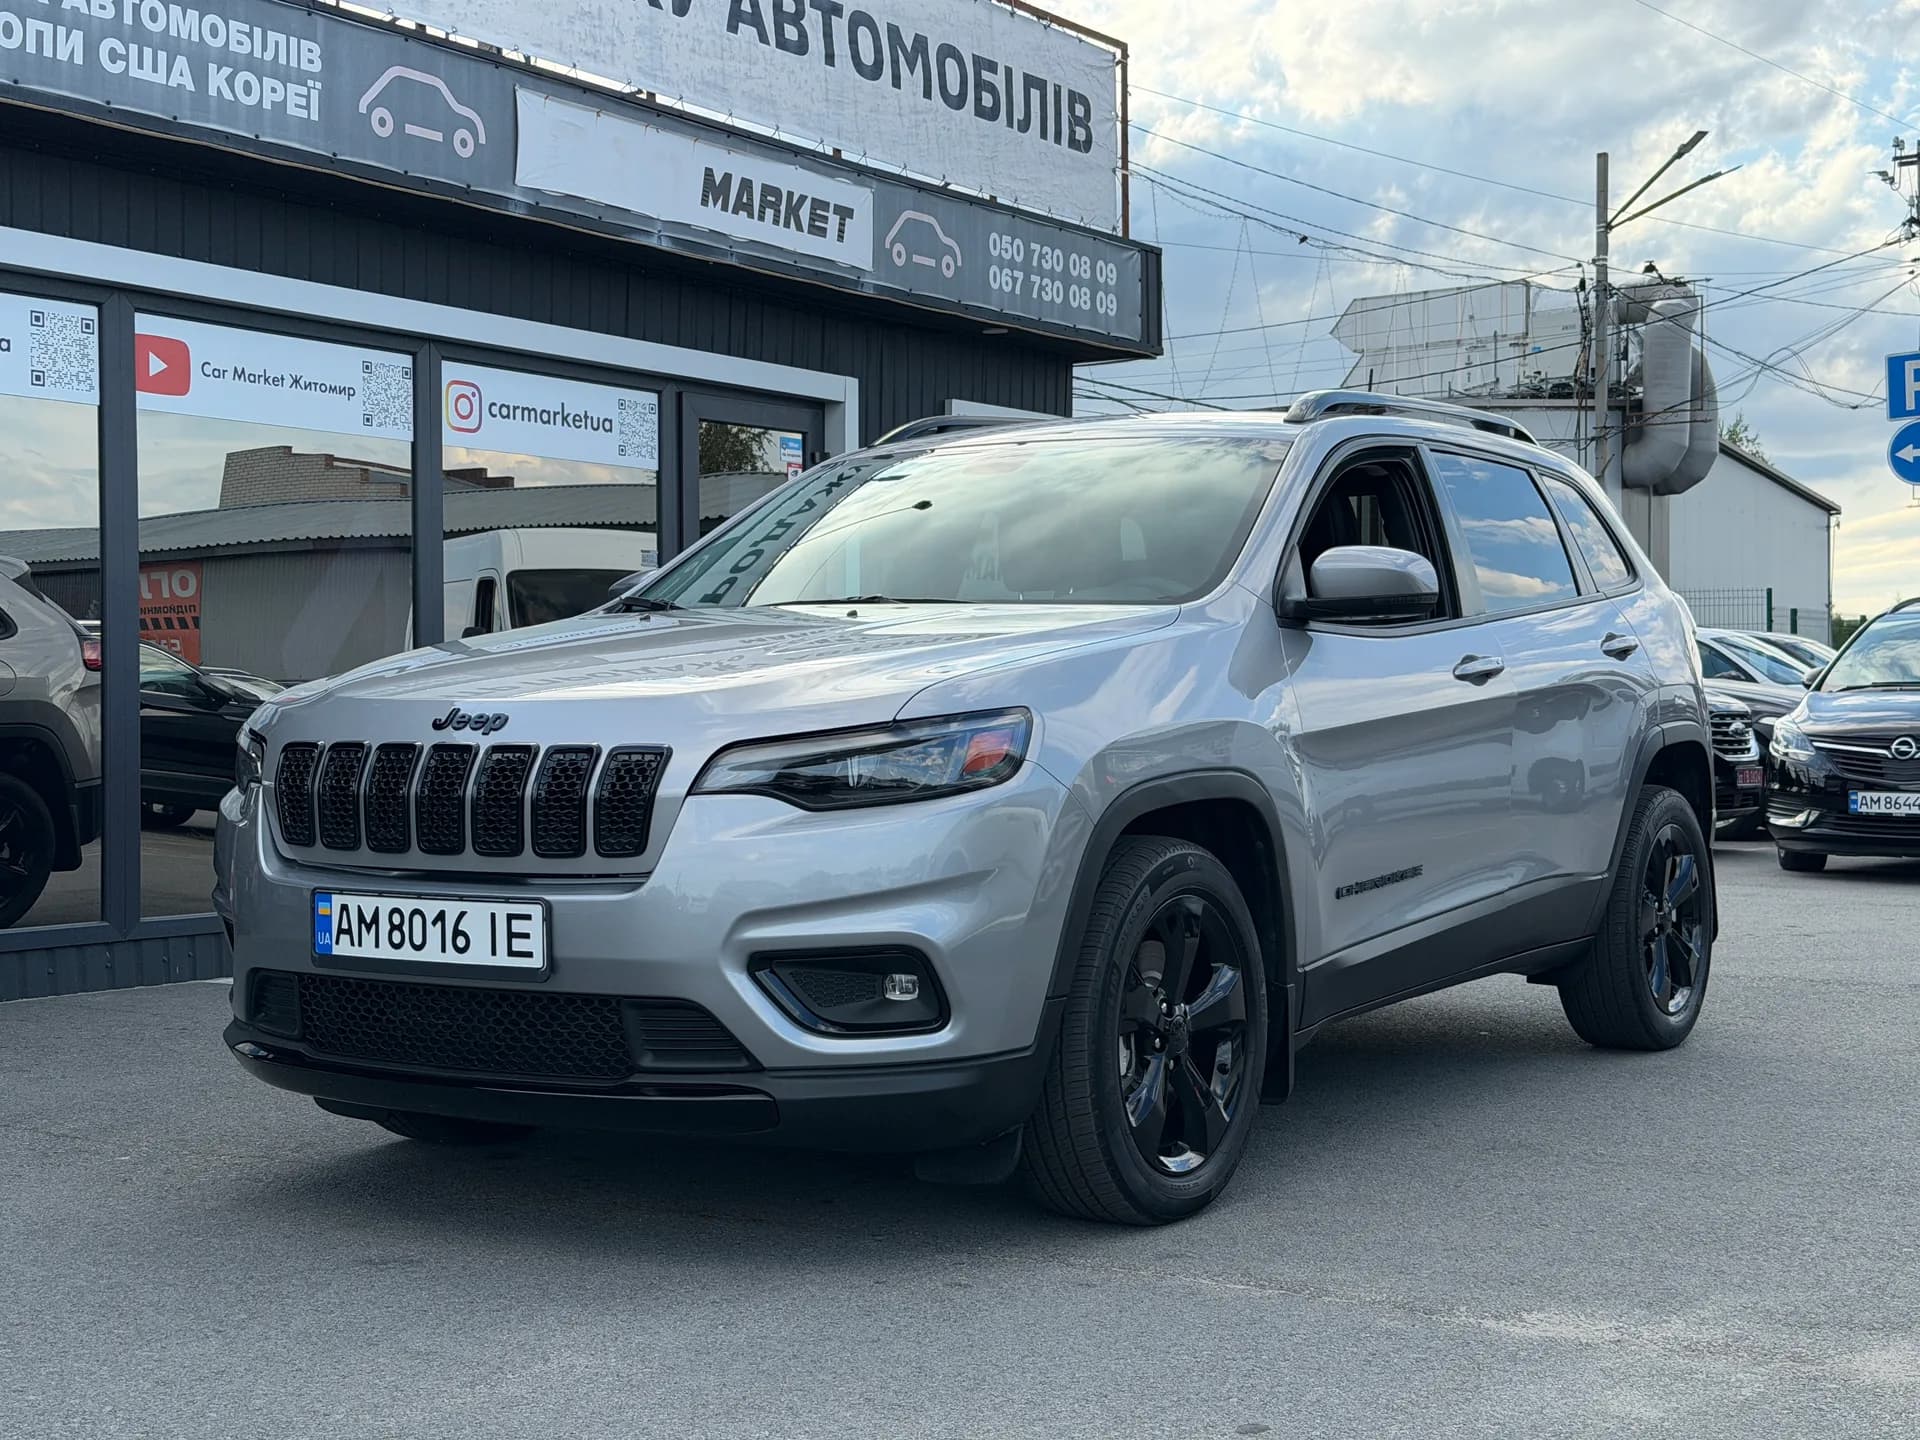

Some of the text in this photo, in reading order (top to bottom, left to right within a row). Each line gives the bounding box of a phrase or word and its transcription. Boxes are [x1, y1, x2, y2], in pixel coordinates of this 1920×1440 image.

[99, 37, 196, 92] США
[208, 63, 323, 121] КОРЕЇ
[726, 0, 1093, 154] АВТОМОБІЛІВ
[700, 166, 855, 244] MARKET
[989, 232, 1117, 286] 050 730 08 09
[989, 264, 1117, 316] 067 730 08 09
[201, 361, 356, 401] Car Market Житомир
[488, 402, 613, 433] carmarketua
[432, 707, 509, 735] Jeep
[318, 931, 331, 946] UA
